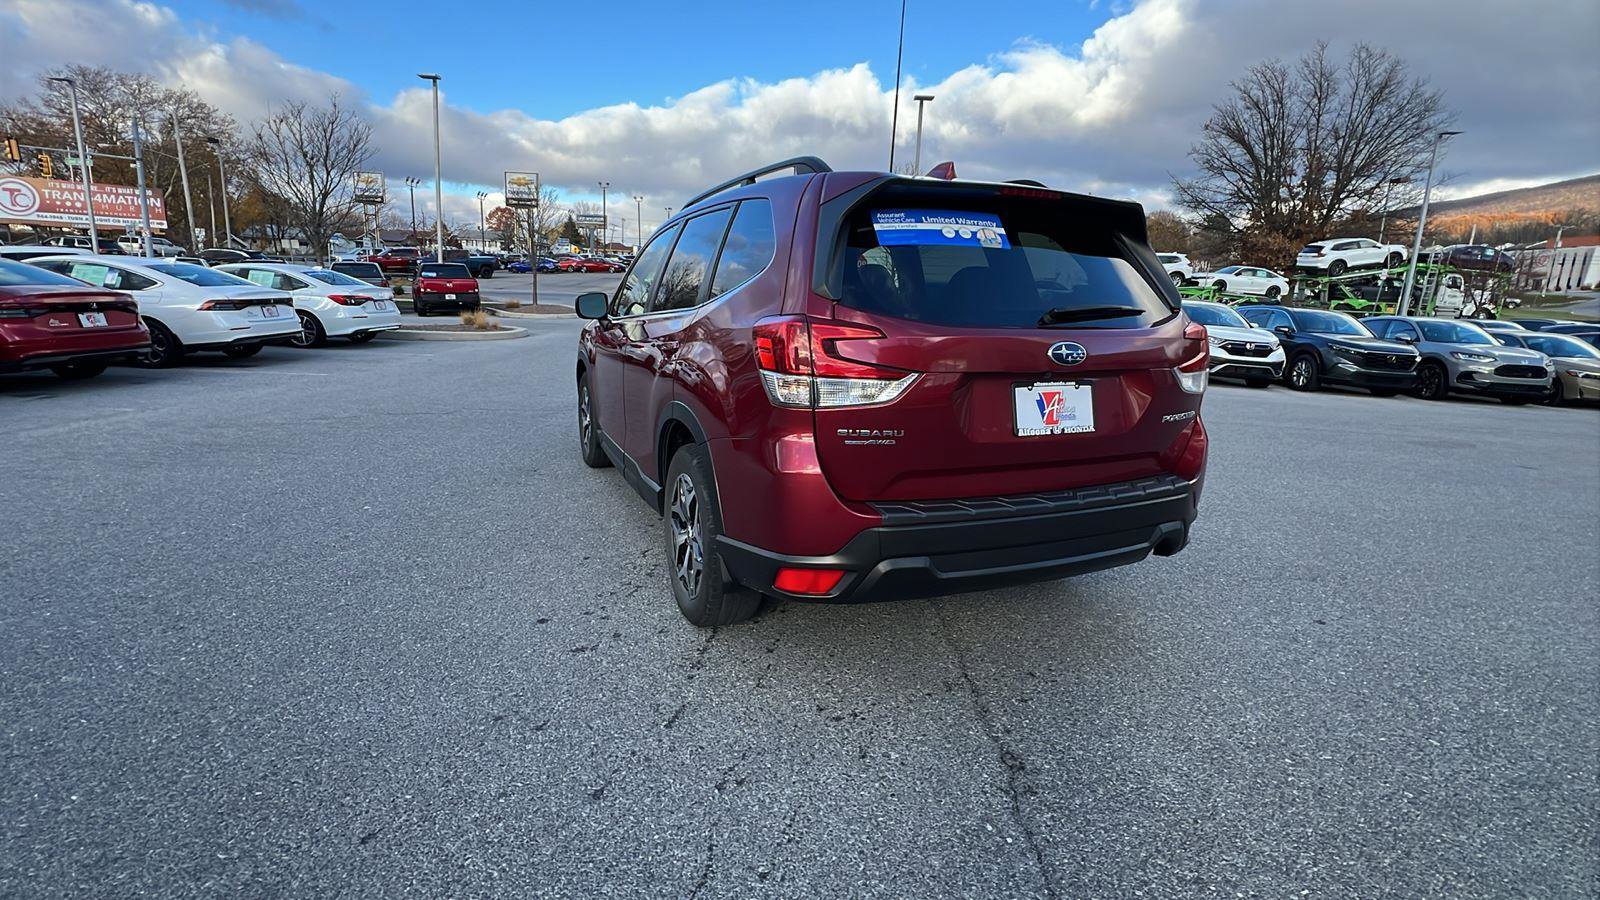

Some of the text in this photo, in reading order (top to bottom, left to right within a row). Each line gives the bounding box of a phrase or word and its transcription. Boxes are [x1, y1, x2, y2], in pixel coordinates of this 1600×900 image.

[41, 188, 161, 208] TRAN4MATION
[921, 216, 997, 229] Limited Warranty
[836, 428, 905, 437] SUBARU
[1063, 424, 1096, 434] HONDA
